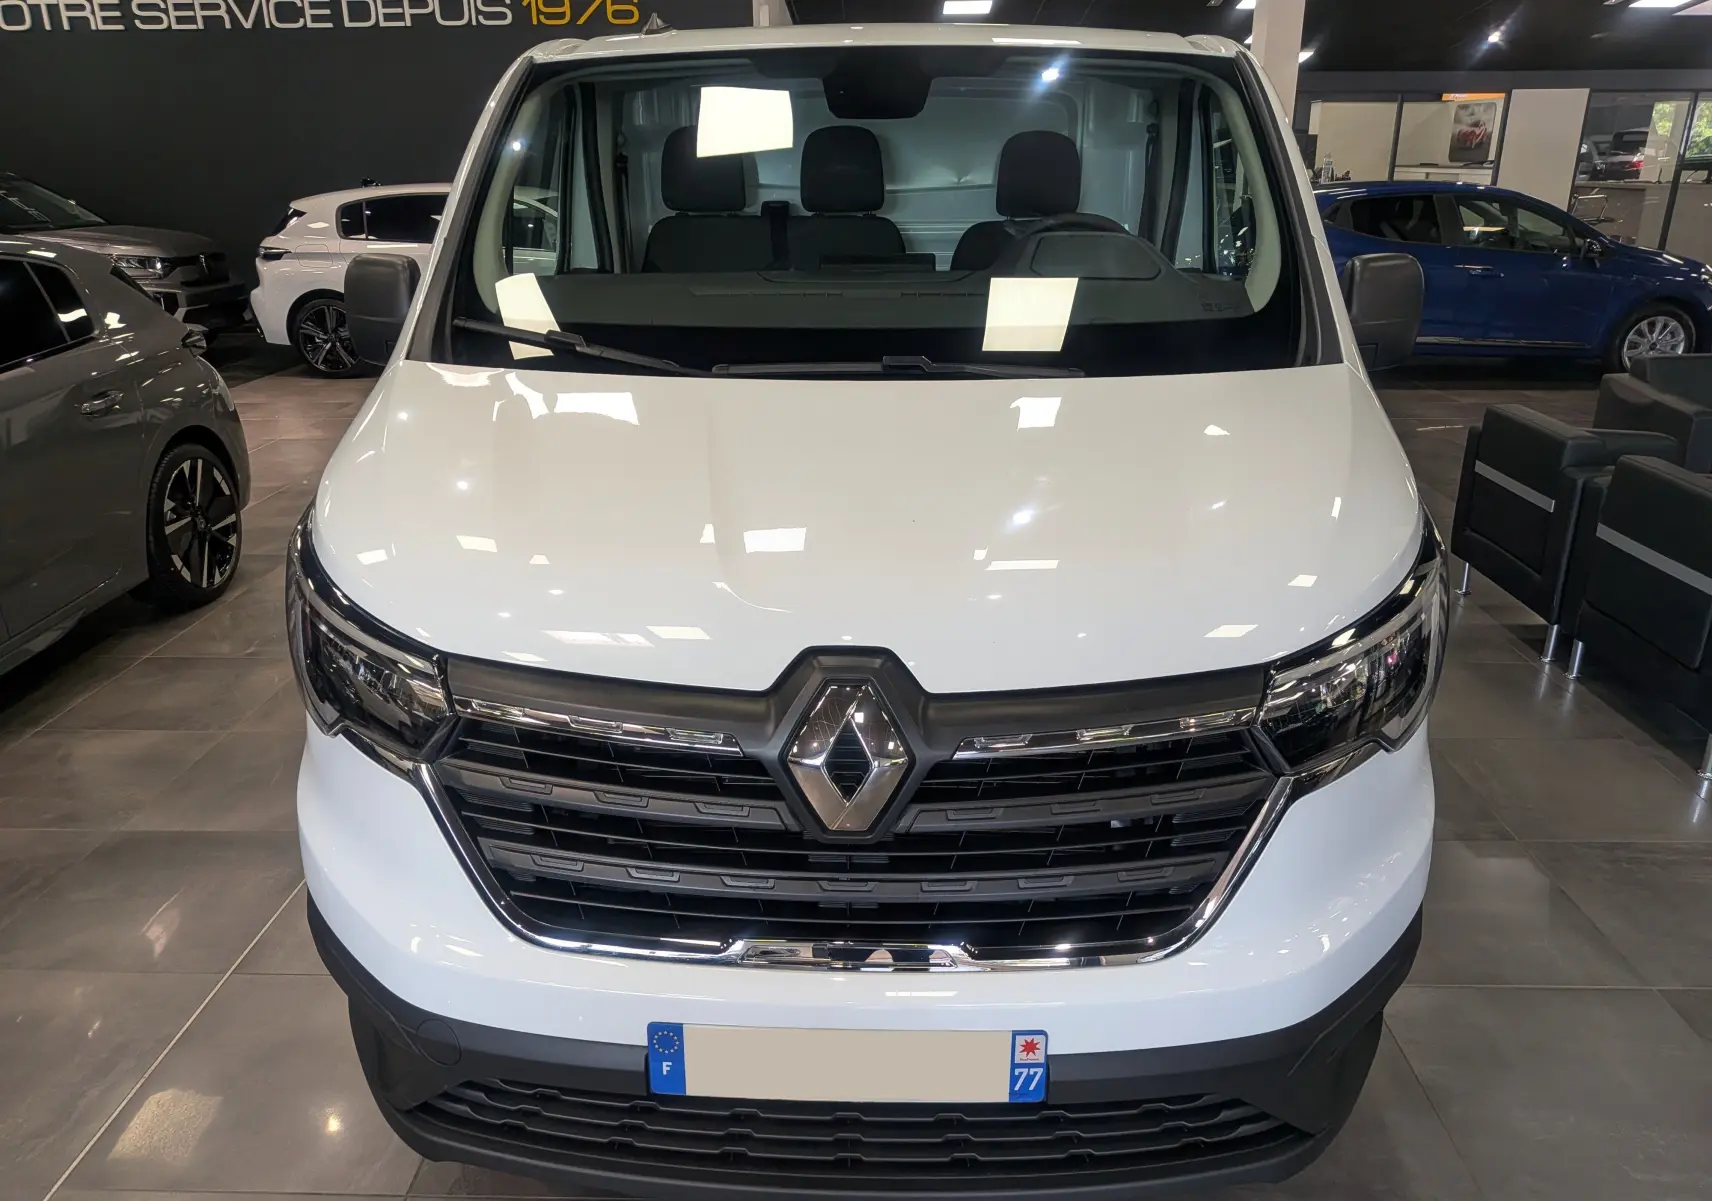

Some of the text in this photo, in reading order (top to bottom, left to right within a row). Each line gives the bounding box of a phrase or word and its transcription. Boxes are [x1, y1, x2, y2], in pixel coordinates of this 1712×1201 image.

[131, 0, 334, 30] SERVICE
[341, 0, 513, 28] DEPUIS
[662, 1061, 673, 1075] F
[1014, 1068, 1043, 1091] 77
